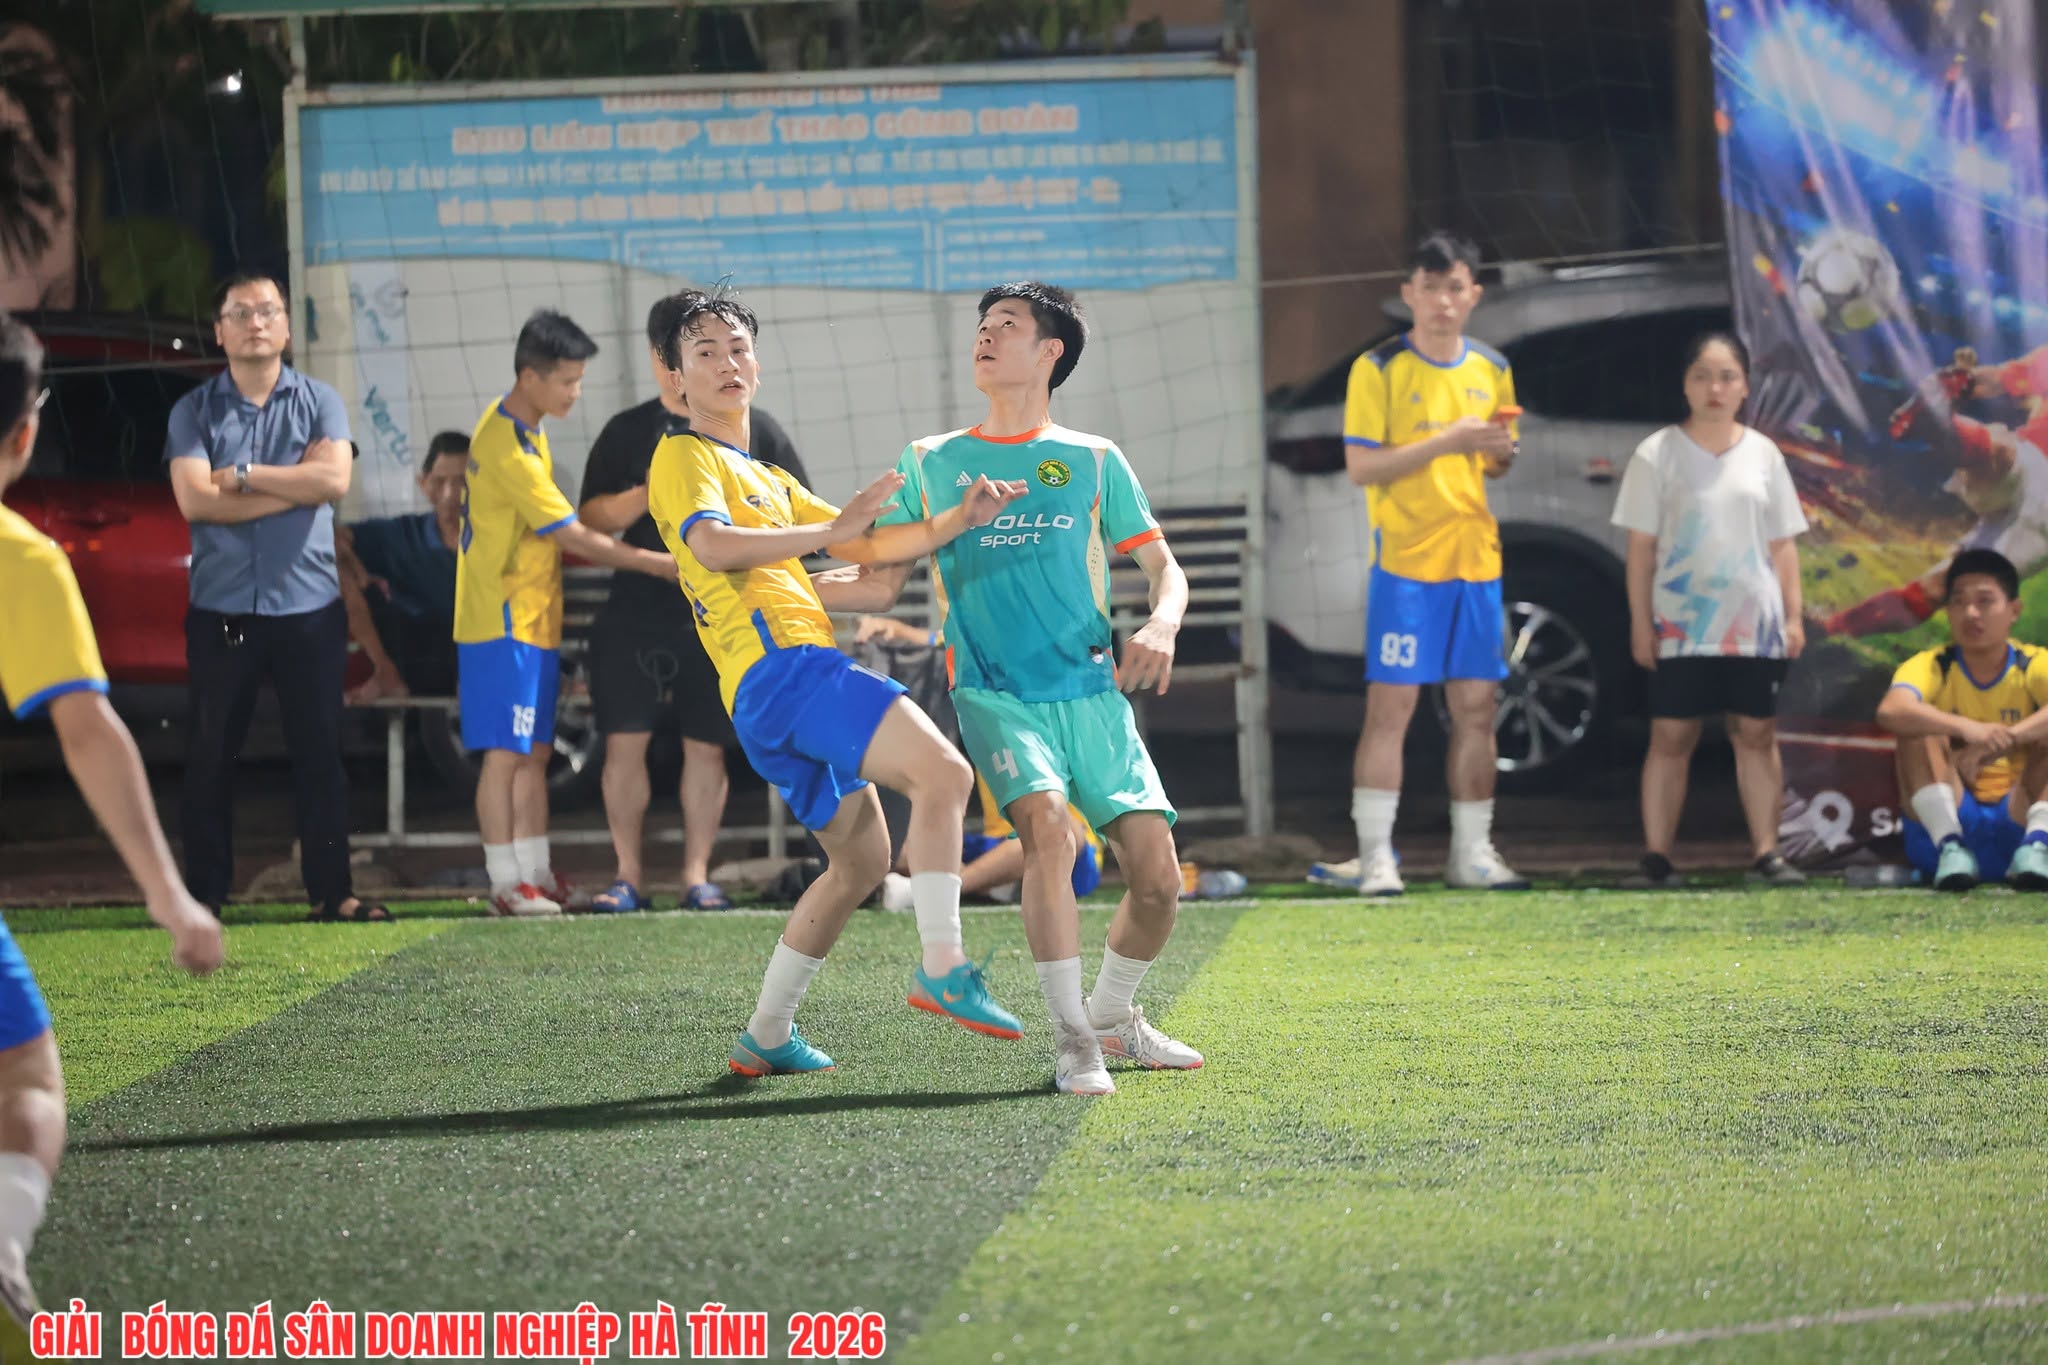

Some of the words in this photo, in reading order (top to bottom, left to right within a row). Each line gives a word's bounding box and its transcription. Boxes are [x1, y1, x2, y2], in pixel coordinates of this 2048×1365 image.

[777, 113, 868, 142] THAO
[873, 108, 973, 139] CÔNG
[969, 513, 1075, 531] OLLO
[979, 531, 1042, 549] sport
[1380, 632, 1418, 668] 93
[991, 748, 1020, 779] 4
